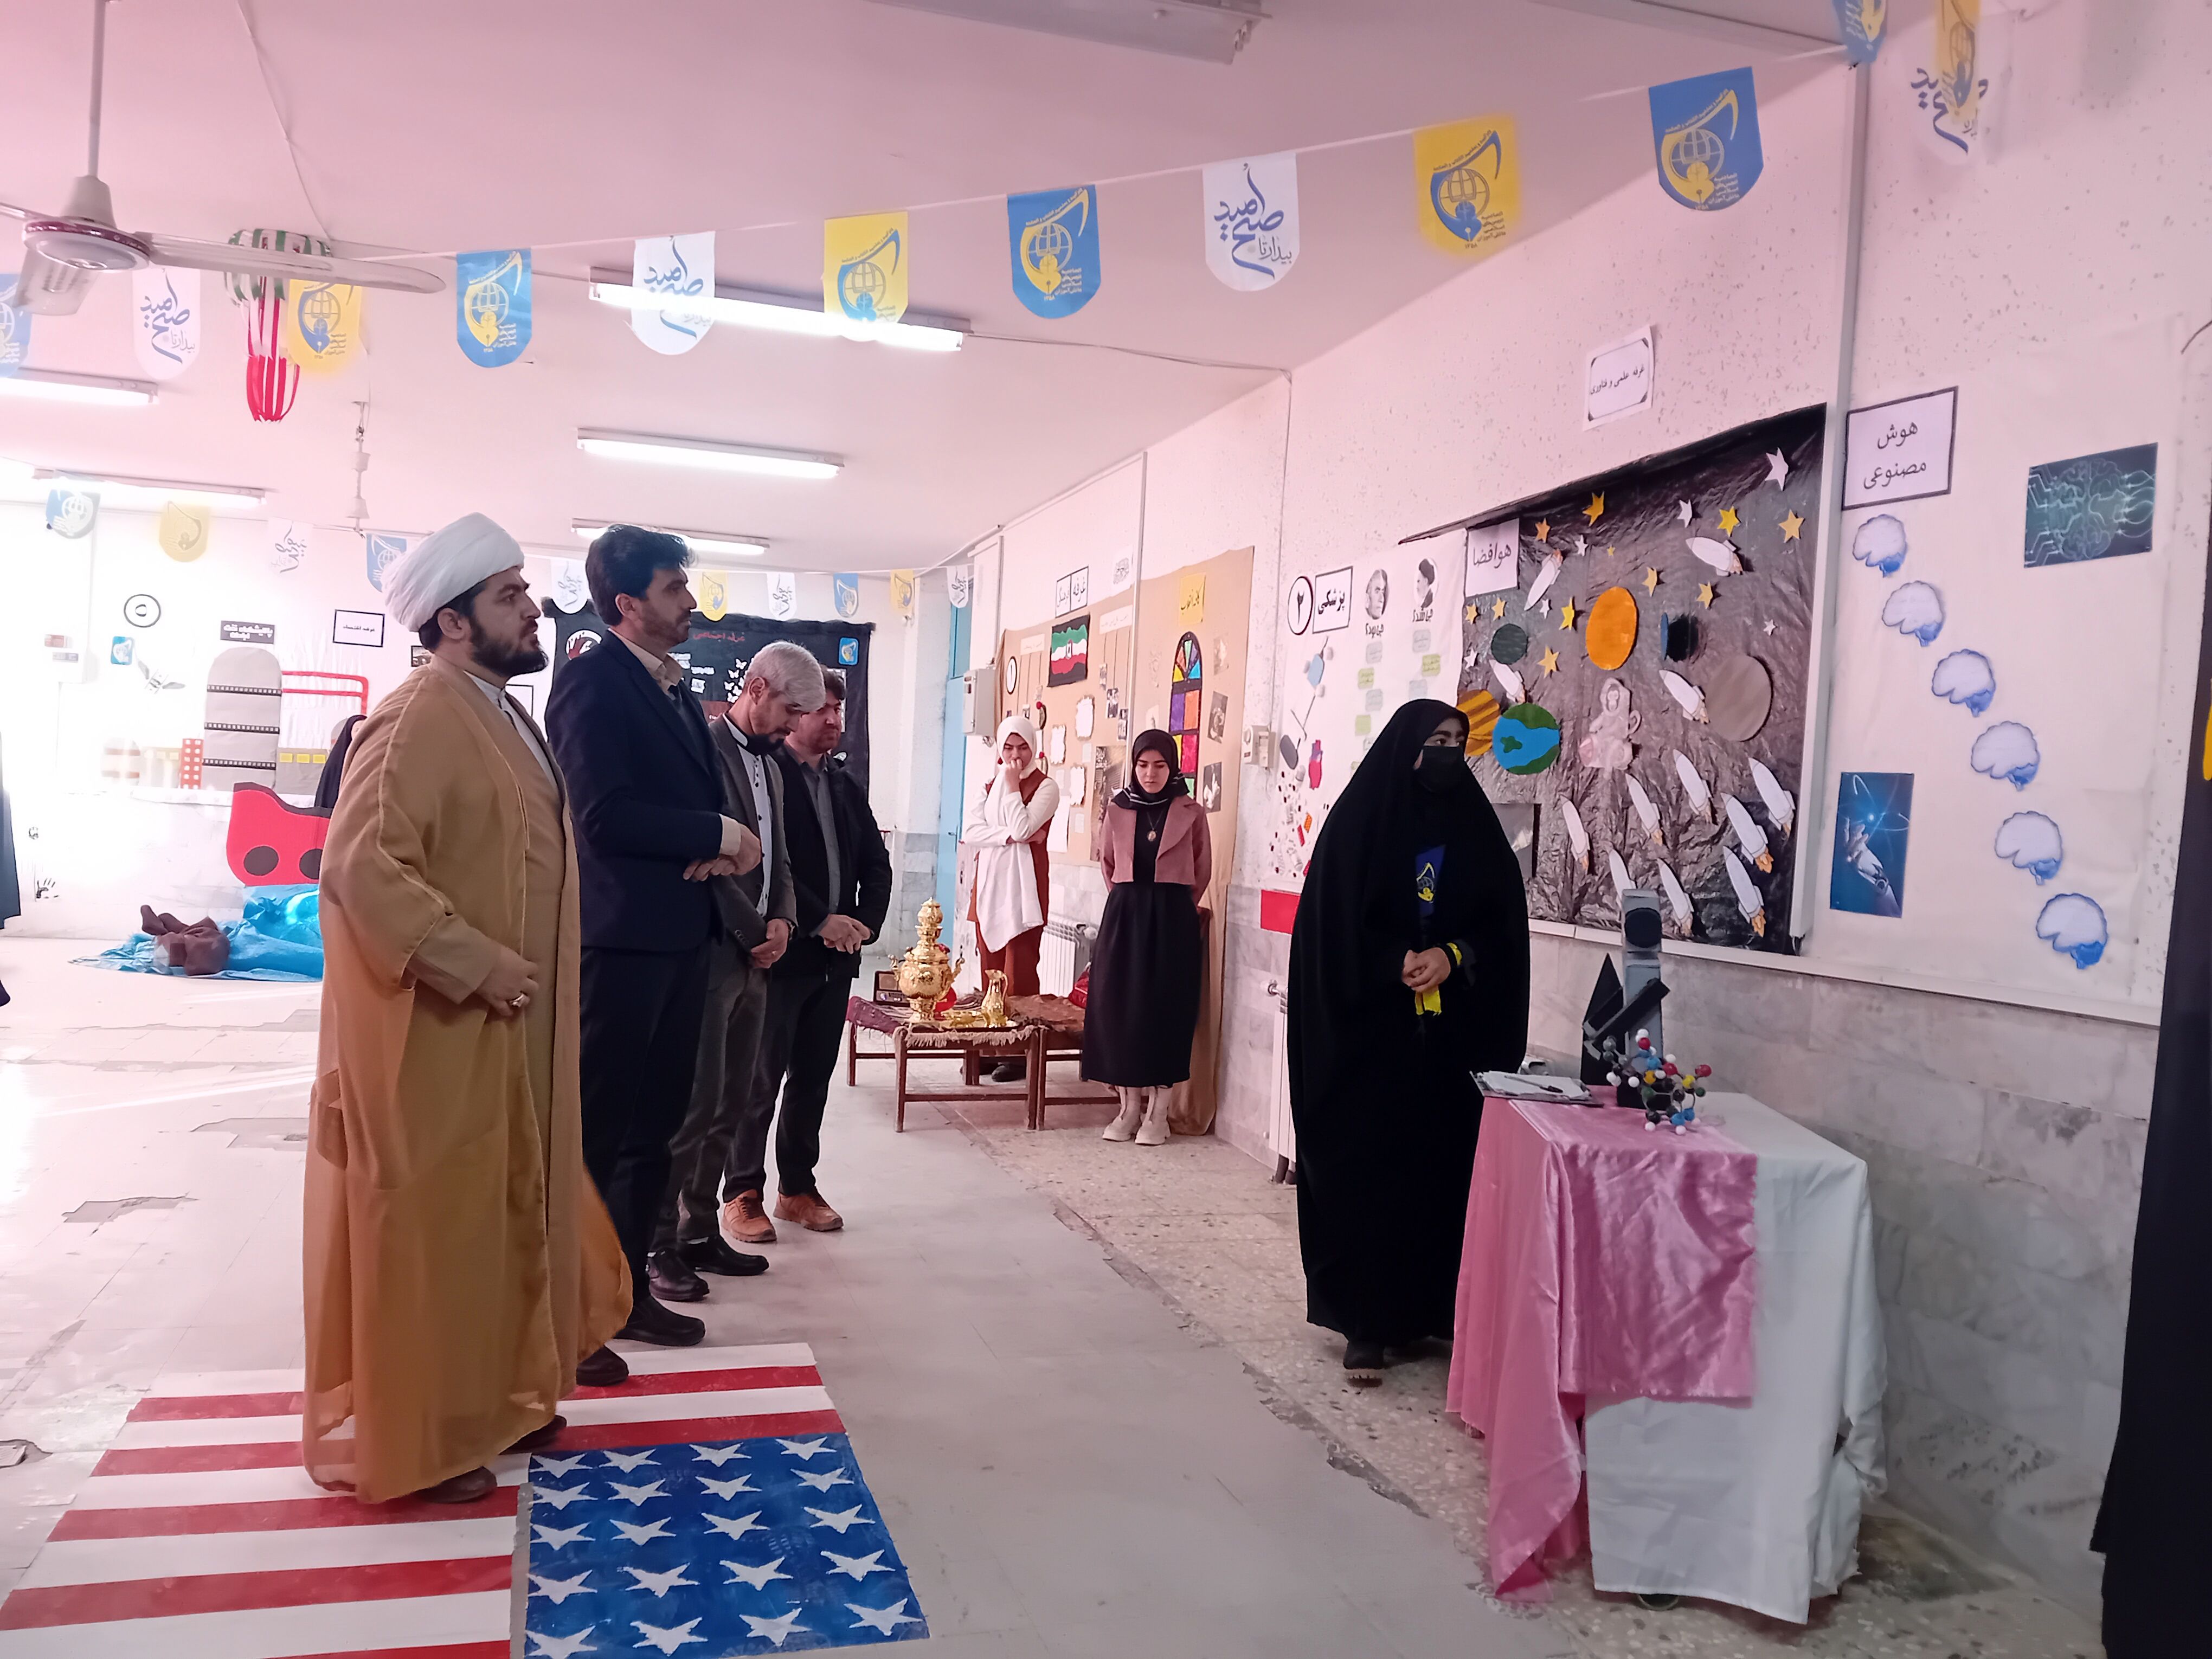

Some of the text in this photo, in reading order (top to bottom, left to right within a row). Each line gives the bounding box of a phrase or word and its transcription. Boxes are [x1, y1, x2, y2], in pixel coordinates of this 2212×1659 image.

[1590, 364, 1645, 395] غرفه علمی و فناوری
[1877, 422, 1918, 449] هوش
[1863, 462, 1926, 490] مصنوعی
[1073, 576, 1086, 602] غرفه
[1318, 588, 1346, 614] پزشکی
[1296, 590, 1304, 625] ۲
